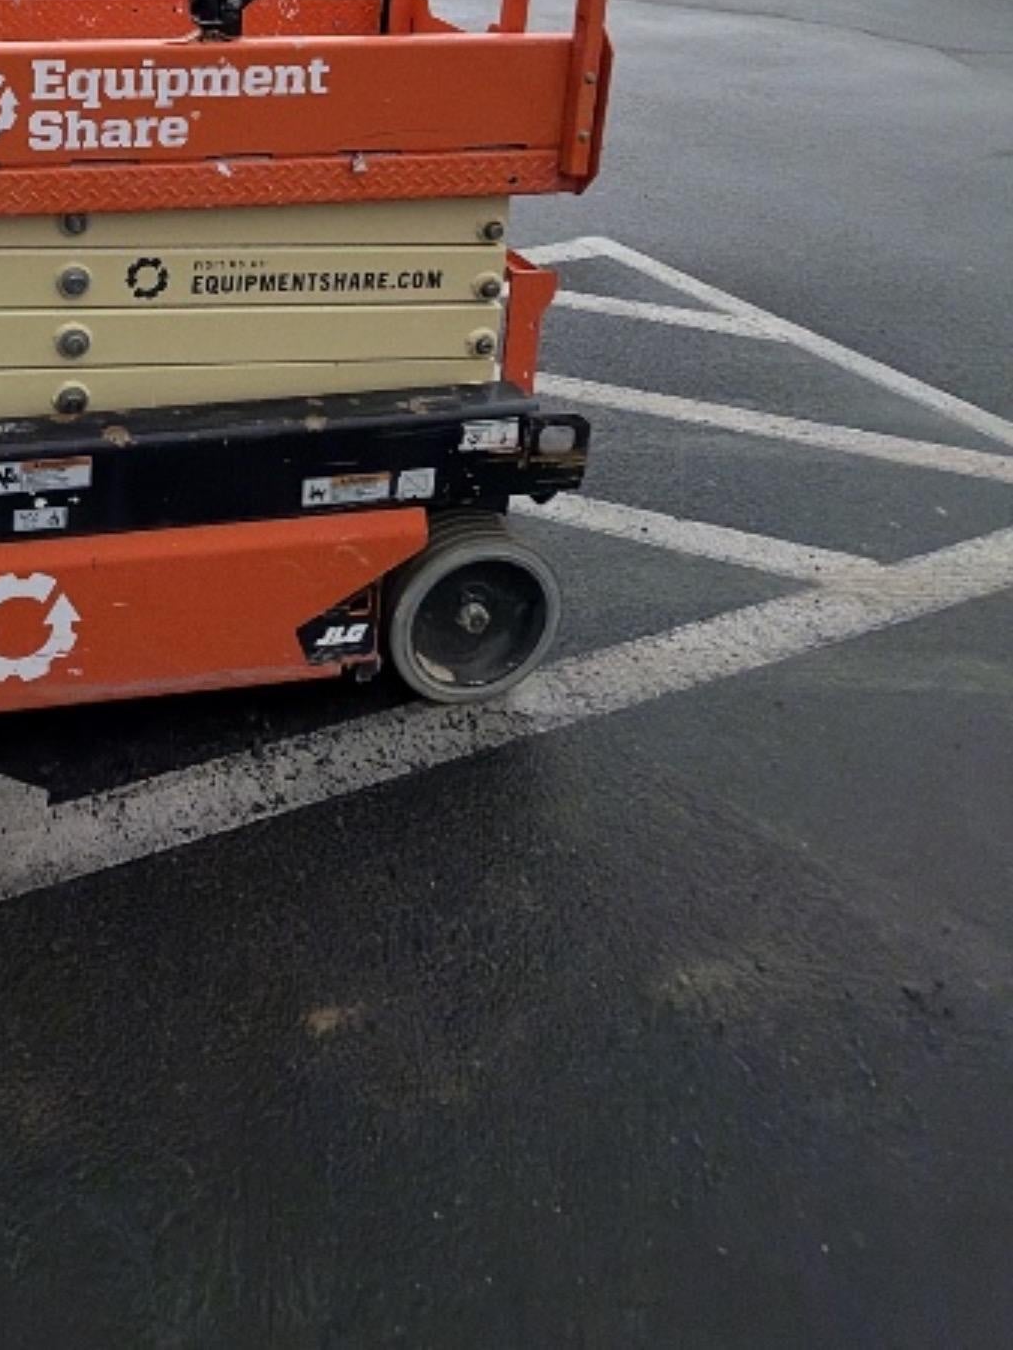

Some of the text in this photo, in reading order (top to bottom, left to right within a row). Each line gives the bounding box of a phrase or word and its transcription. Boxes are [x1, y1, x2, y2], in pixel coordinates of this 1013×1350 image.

[31, 58, 330, 109] Equipment
[28, 110, 189, 151] Share
[191, 270, 444, 295] EQUIPMENTSHARE.COM
